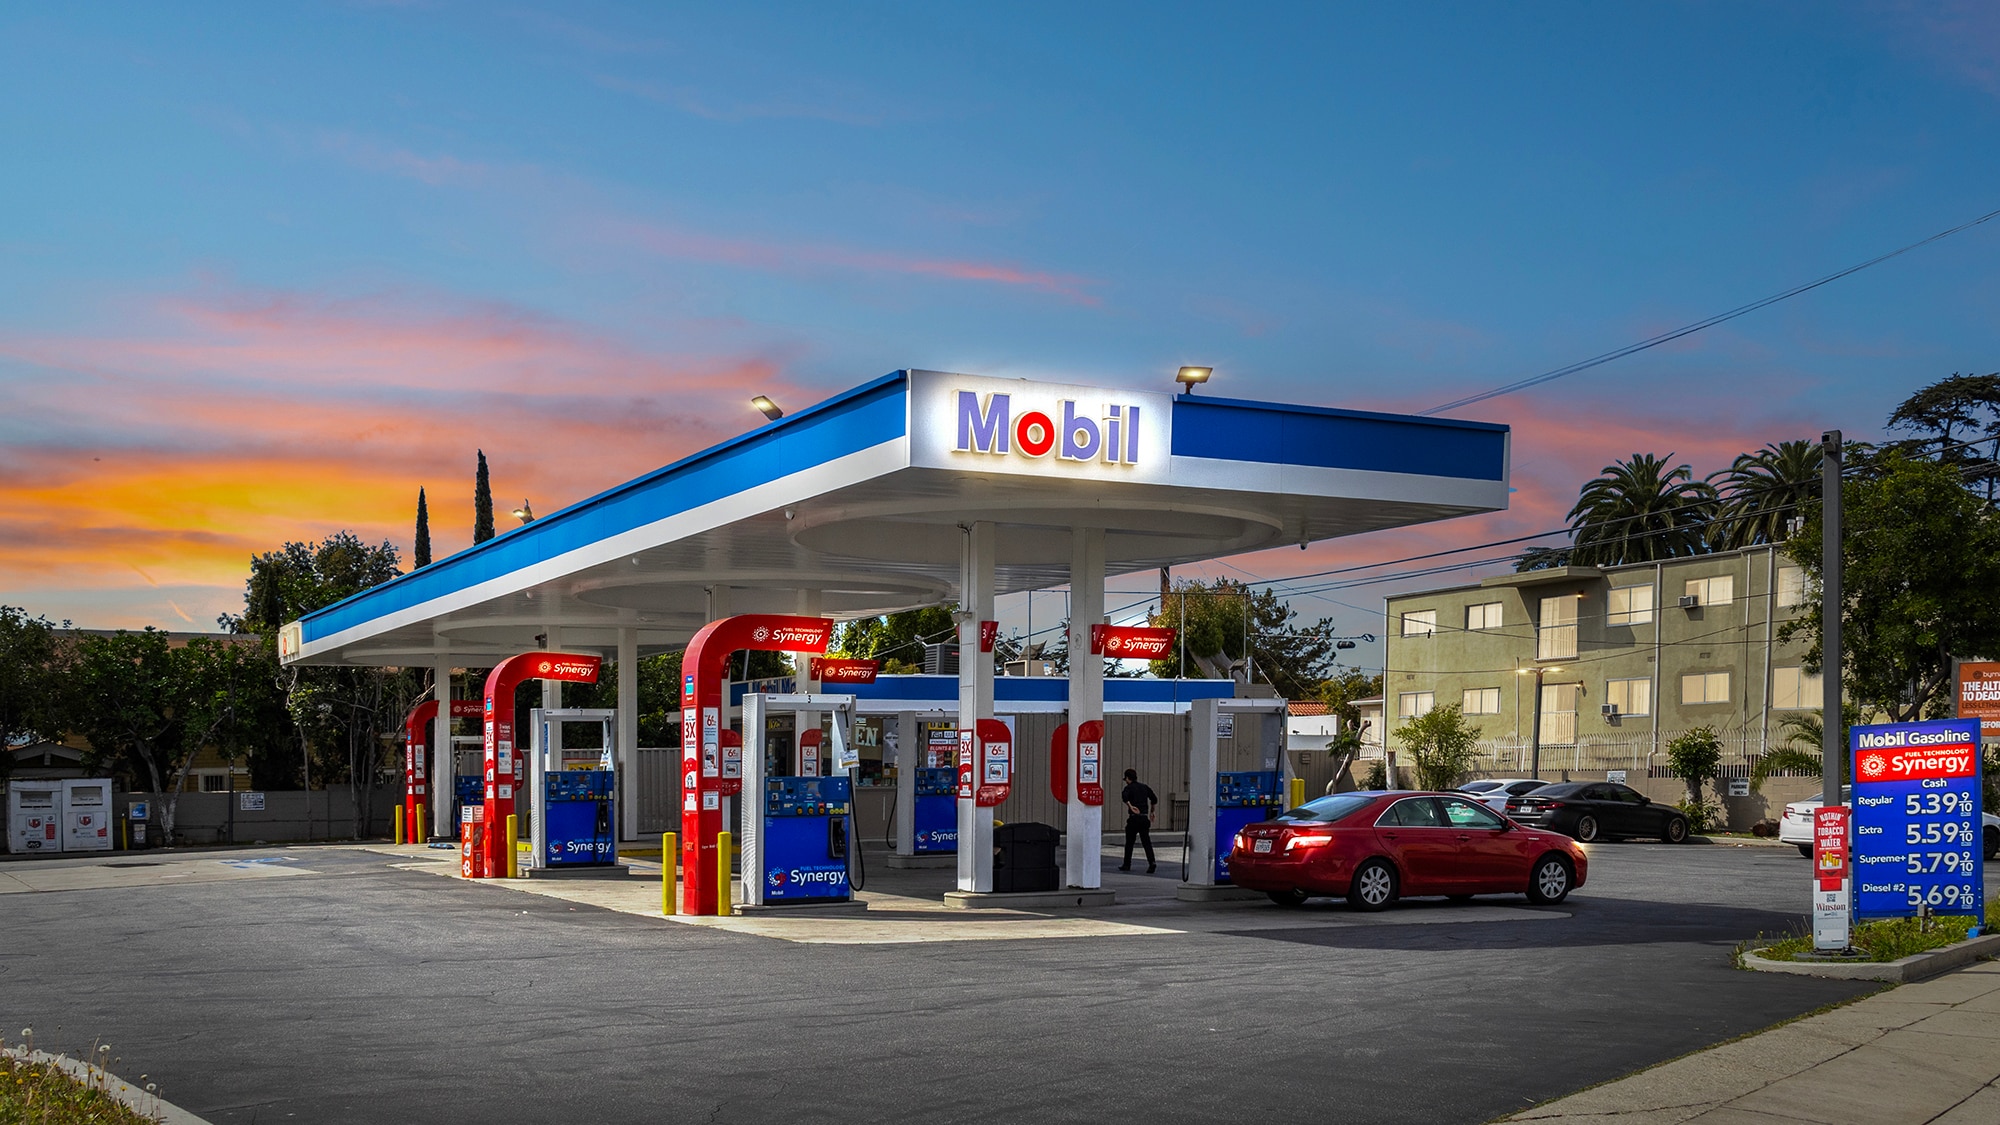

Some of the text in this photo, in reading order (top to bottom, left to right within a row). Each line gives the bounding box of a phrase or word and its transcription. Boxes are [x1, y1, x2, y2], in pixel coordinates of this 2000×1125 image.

[951, 388, 1140, 466] Mobil
[772, 629, 822, 645] Synergy
[982, 628, 986, 638] 3
[1123, 638, 1166, 652] Synergy
[554, 664, 594, 676] Synergy
[838, 668, 872, 678] Synergy
[1962, 681, 1981, 692] THE
[1962, 692, 1974, 702] TO
[686, 722, 696, 738] 3X
[856, 727, 878, 746] EN
[1859, 730, 1970, 748] Mobil Gasoline
[962, 741, 971, 754] 3X
[1923, 748, 1969, 756] TECHNOLOGY
[1892, 756, 1970, 775] Synergy
[1922, 778, 1948, 788] Cash
[1858, 792, 1958, 814] Regular 5.39
[1959, 802, 1972, 812] 10
[1818, 826, 1844, 836] TOBACCO
[1858, 822, 1959, 844] Extra 5.59
[1960, 832, 1973, 842] 10
[1820, 838, 1840, 848] WATER
[1860, 852, 1960, 874] Supreme+ 5.79
[1960, 862, 1974, 872] 10
[790, 870, 846, 886] Synergy
[1862, 884, 1960, 906] Diesel #2 5.69
[1960, 896, 1974, 905] 10
[1816, 902, 1846, 911] Winston
